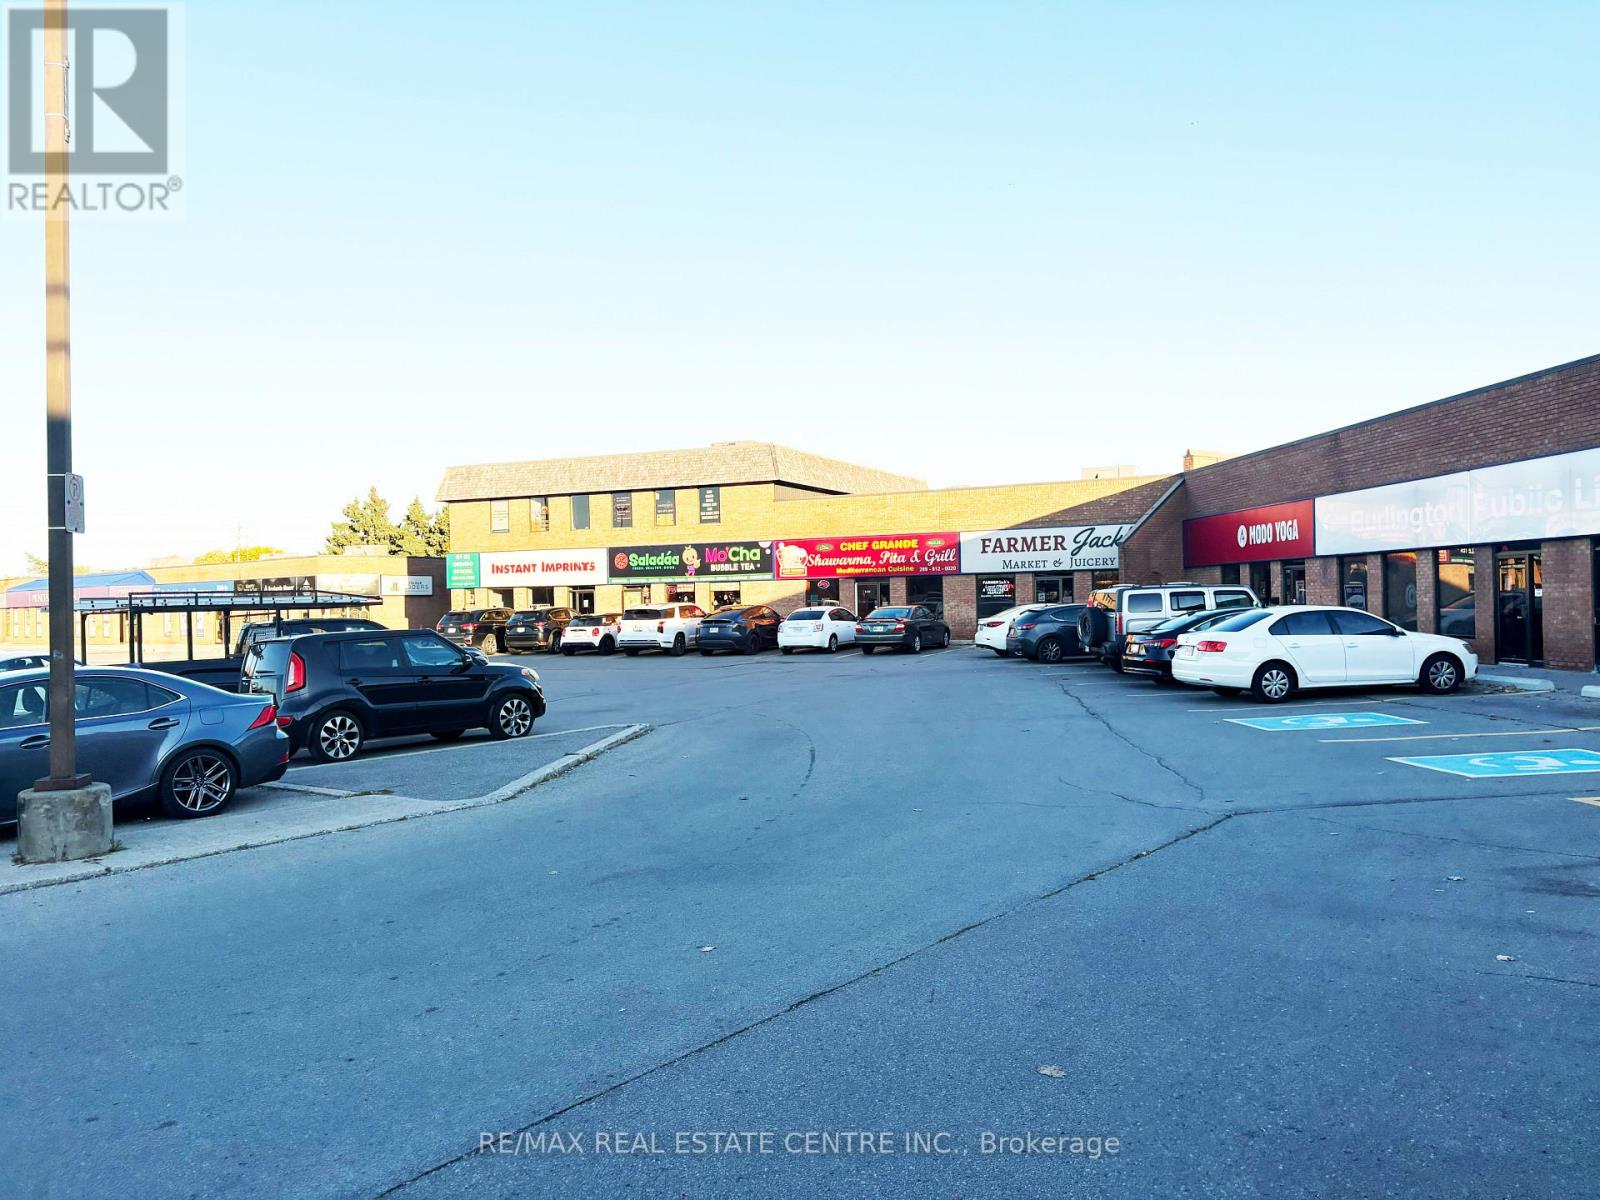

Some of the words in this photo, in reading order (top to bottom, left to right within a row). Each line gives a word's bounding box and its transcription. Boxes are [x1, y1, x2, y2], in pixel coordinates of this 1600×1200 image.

[1249, 523, 1273, 545] MODO
[1275, 519, 1299, 542] YOGA
[840, 541, 869, 551] CHEF
[872, 539, 918, 550] GRANDE
[981, 534, 1067, 553] FARMER
[705, 546, 761, 563] Mo'Cha
[807, 553, 876, 567] Shawarma,
[879, 551, 906, 564] Pita
[910, 550, 921, 562] &
[924, 548, 956, 566] Grill
[491, 563, 537, 574] INSTANT
[541, 561, 596, 573] IMPRINTS
[710, 563, 739, 572] BUBBLE
[740, 563, 755, 571] TEA
[836, 566, 886, 574] Mediterranean
[888, 565, 914, 573] Cuisine
[1002, 559, 1048, 570] MARKET
[1053, 558, 1063, 567] &
[1070, 557, 1116, 568] JUICERY
